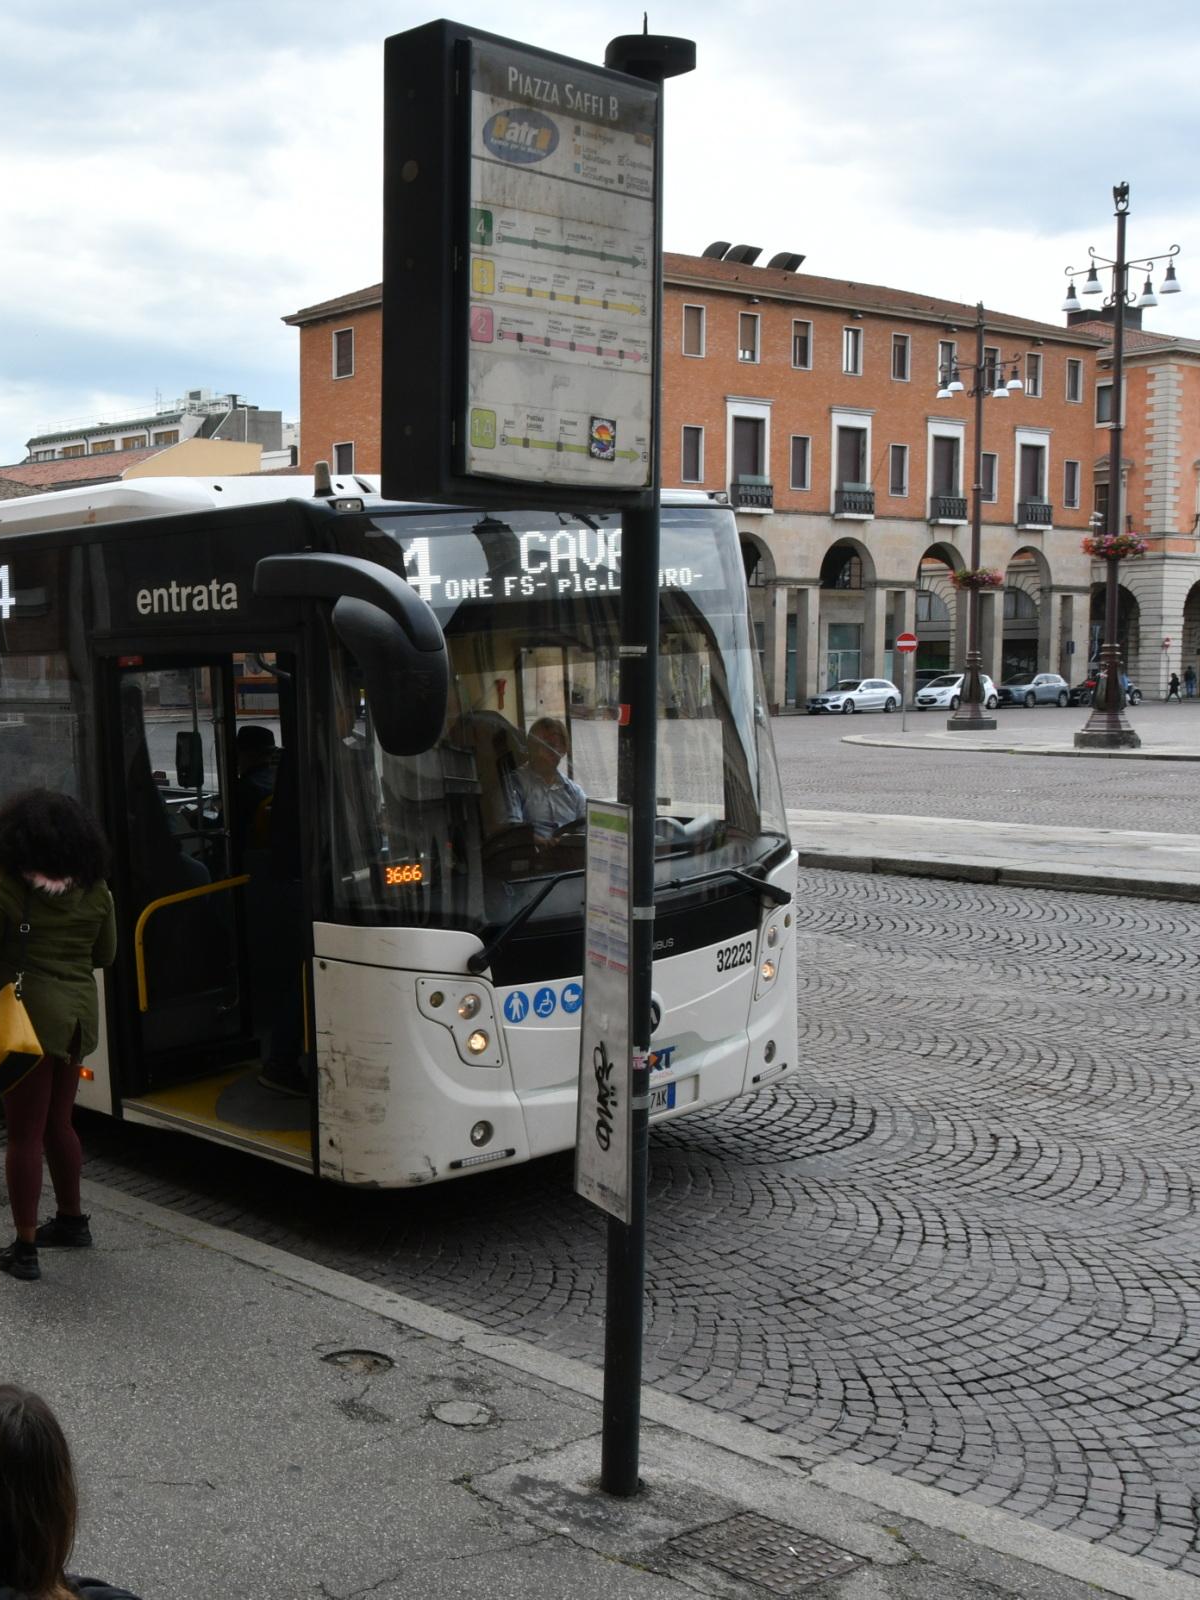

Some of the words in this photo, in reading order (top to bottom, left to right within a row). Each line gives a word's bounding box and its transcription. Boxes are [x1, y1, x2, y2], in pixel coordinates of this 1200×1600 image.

[507, 65, 560, 106] PIAZZA
[564, 83, 604, 118] SAFFI
[608, 96, 619, 121] B
[475, 218, 486, 236] 4
[479, 269, 488, 287] 3
[478, 316, 488, 334] 2
[403, 536, 441, 601] 4
[136, 577, 238, 615] entrata
[385, 864, 423, 885] 3666
[716, 941, 752, 973] 32223
